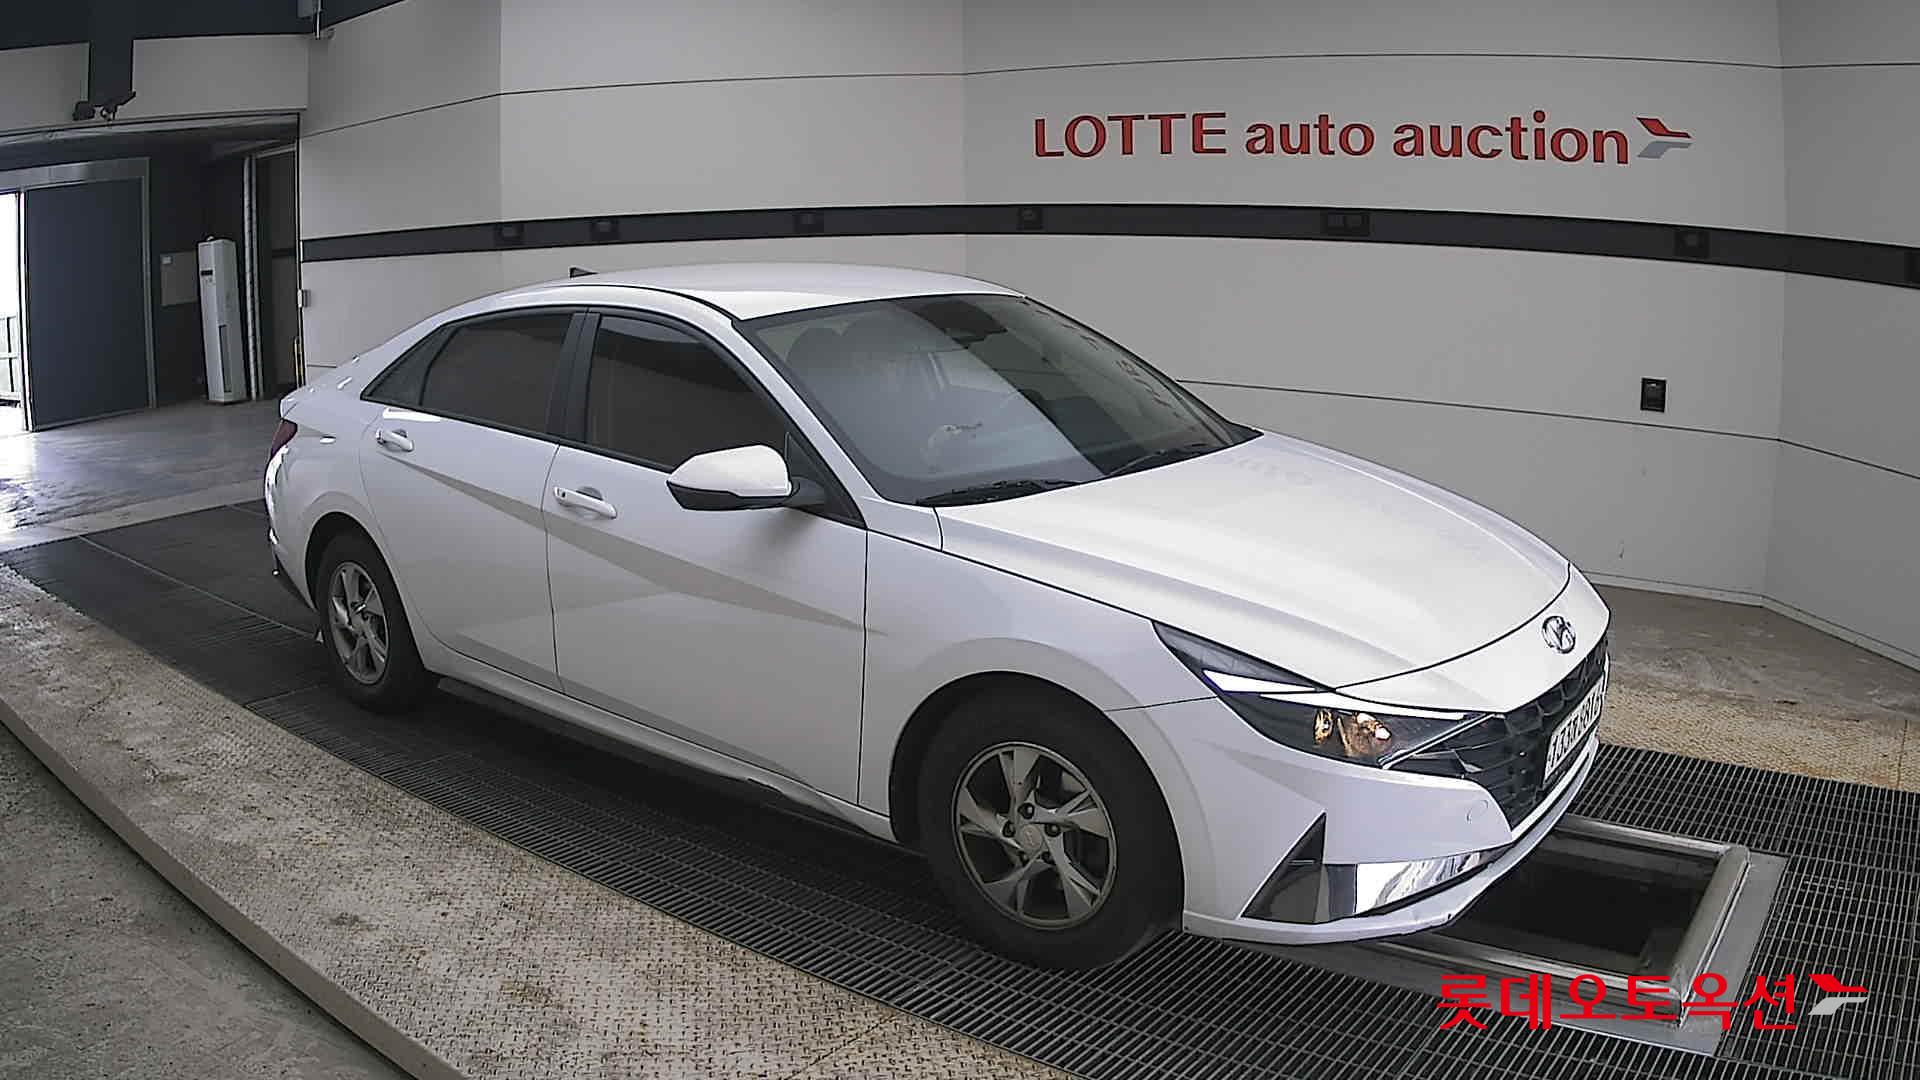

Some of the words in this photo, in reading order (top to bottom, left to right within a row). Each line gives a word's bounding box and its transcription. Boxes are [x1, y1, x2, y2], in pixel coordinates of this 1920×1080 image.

[1034, 112, 1227, 158] LOTTE
[1245, 114, 1375, 156] auto
[1392, 110, 1629, 165] auction
